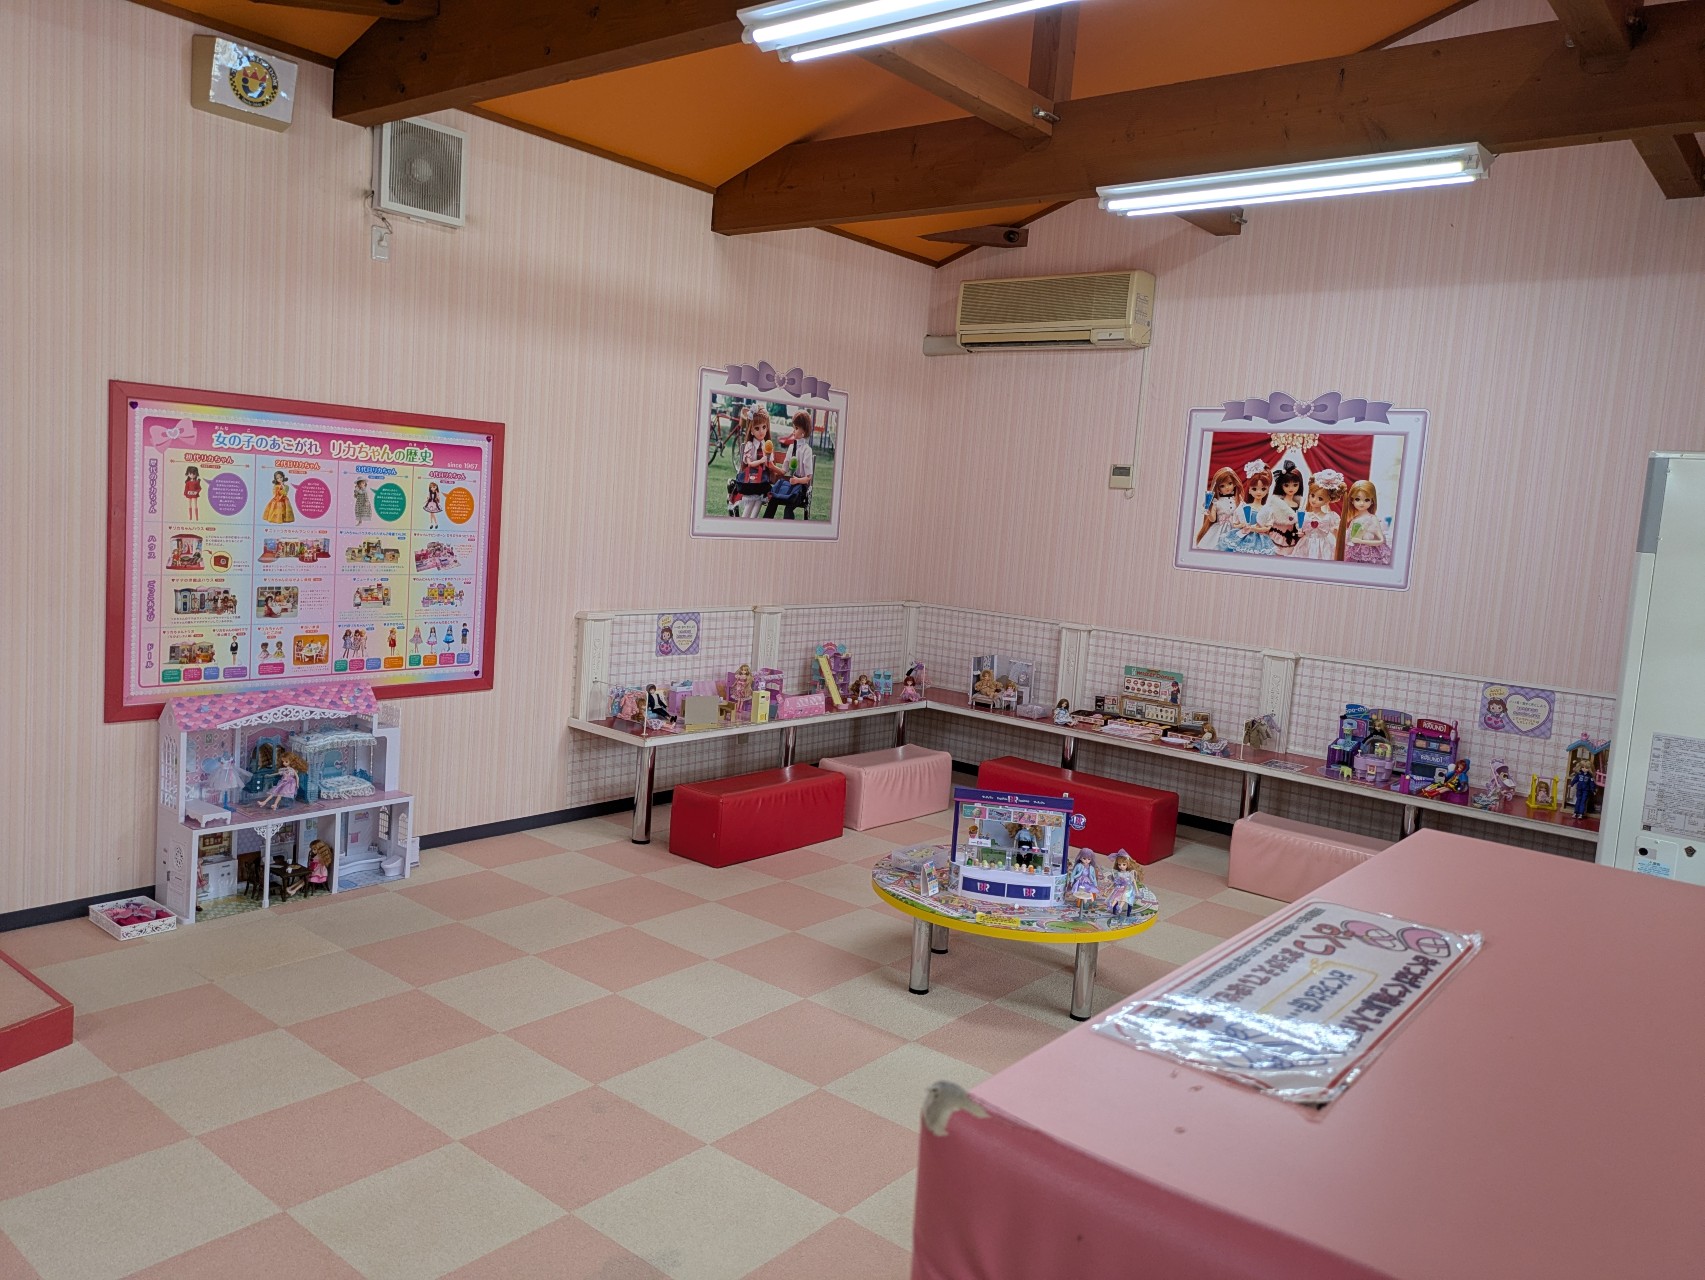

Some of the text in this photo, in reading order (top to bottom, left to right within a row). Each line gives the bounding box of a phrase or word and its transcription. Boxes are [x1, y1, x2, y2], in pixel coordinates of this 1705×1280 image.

[213, 431, 433, 465] 女の子のあこがれ リカちゃんの歴史
[184, 452, 234, 464] 初代リカちゃん
[977, 882, 990, 893] BR
[1022, 887, 1036, 898] BR
